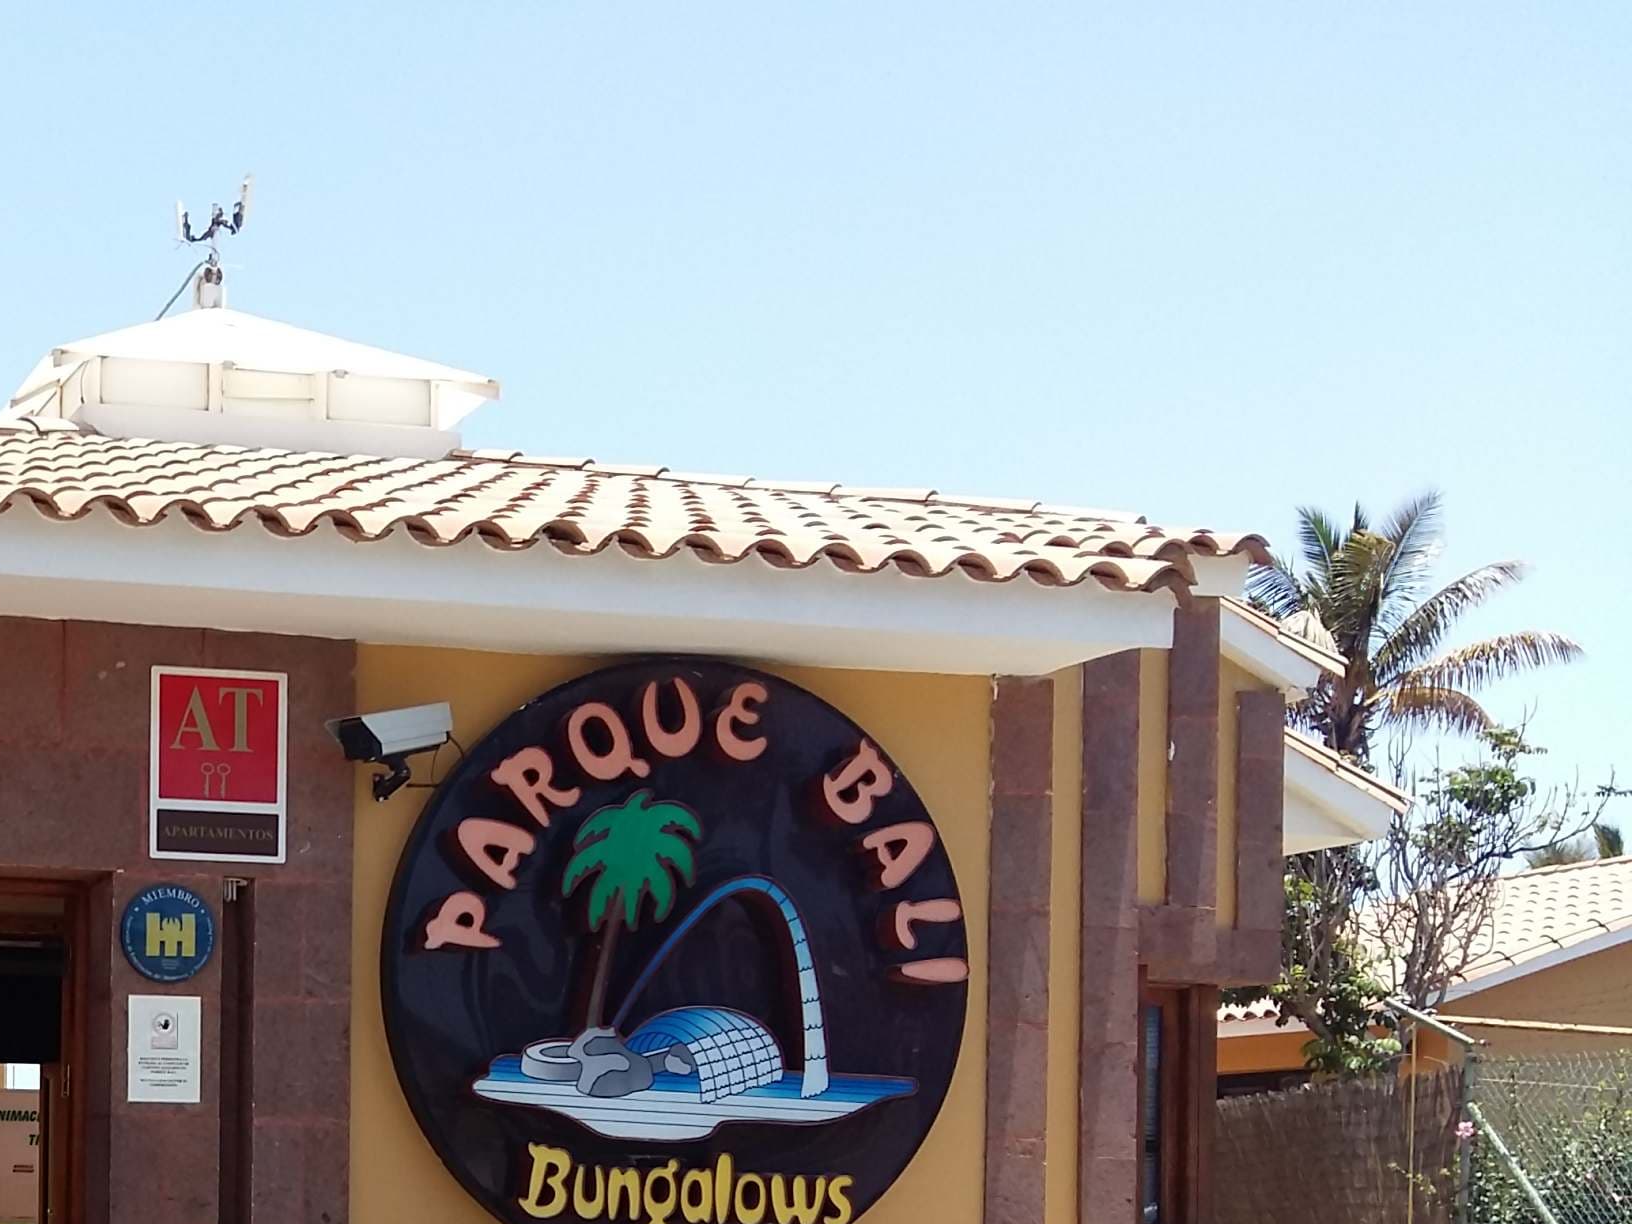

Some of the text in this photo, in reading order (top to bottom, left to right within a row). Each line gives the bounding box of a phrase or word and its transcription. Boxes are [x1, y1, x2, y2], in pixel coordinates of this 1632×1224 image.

[169, 685, 264, 753] AT
[163, 824, 275, 842] APARTAMENTOS
[424, 677, 770, 951] PARQUE
[822, 738, 970, 984] BALI
[141, 887, 200, 909] MIEMBRO
